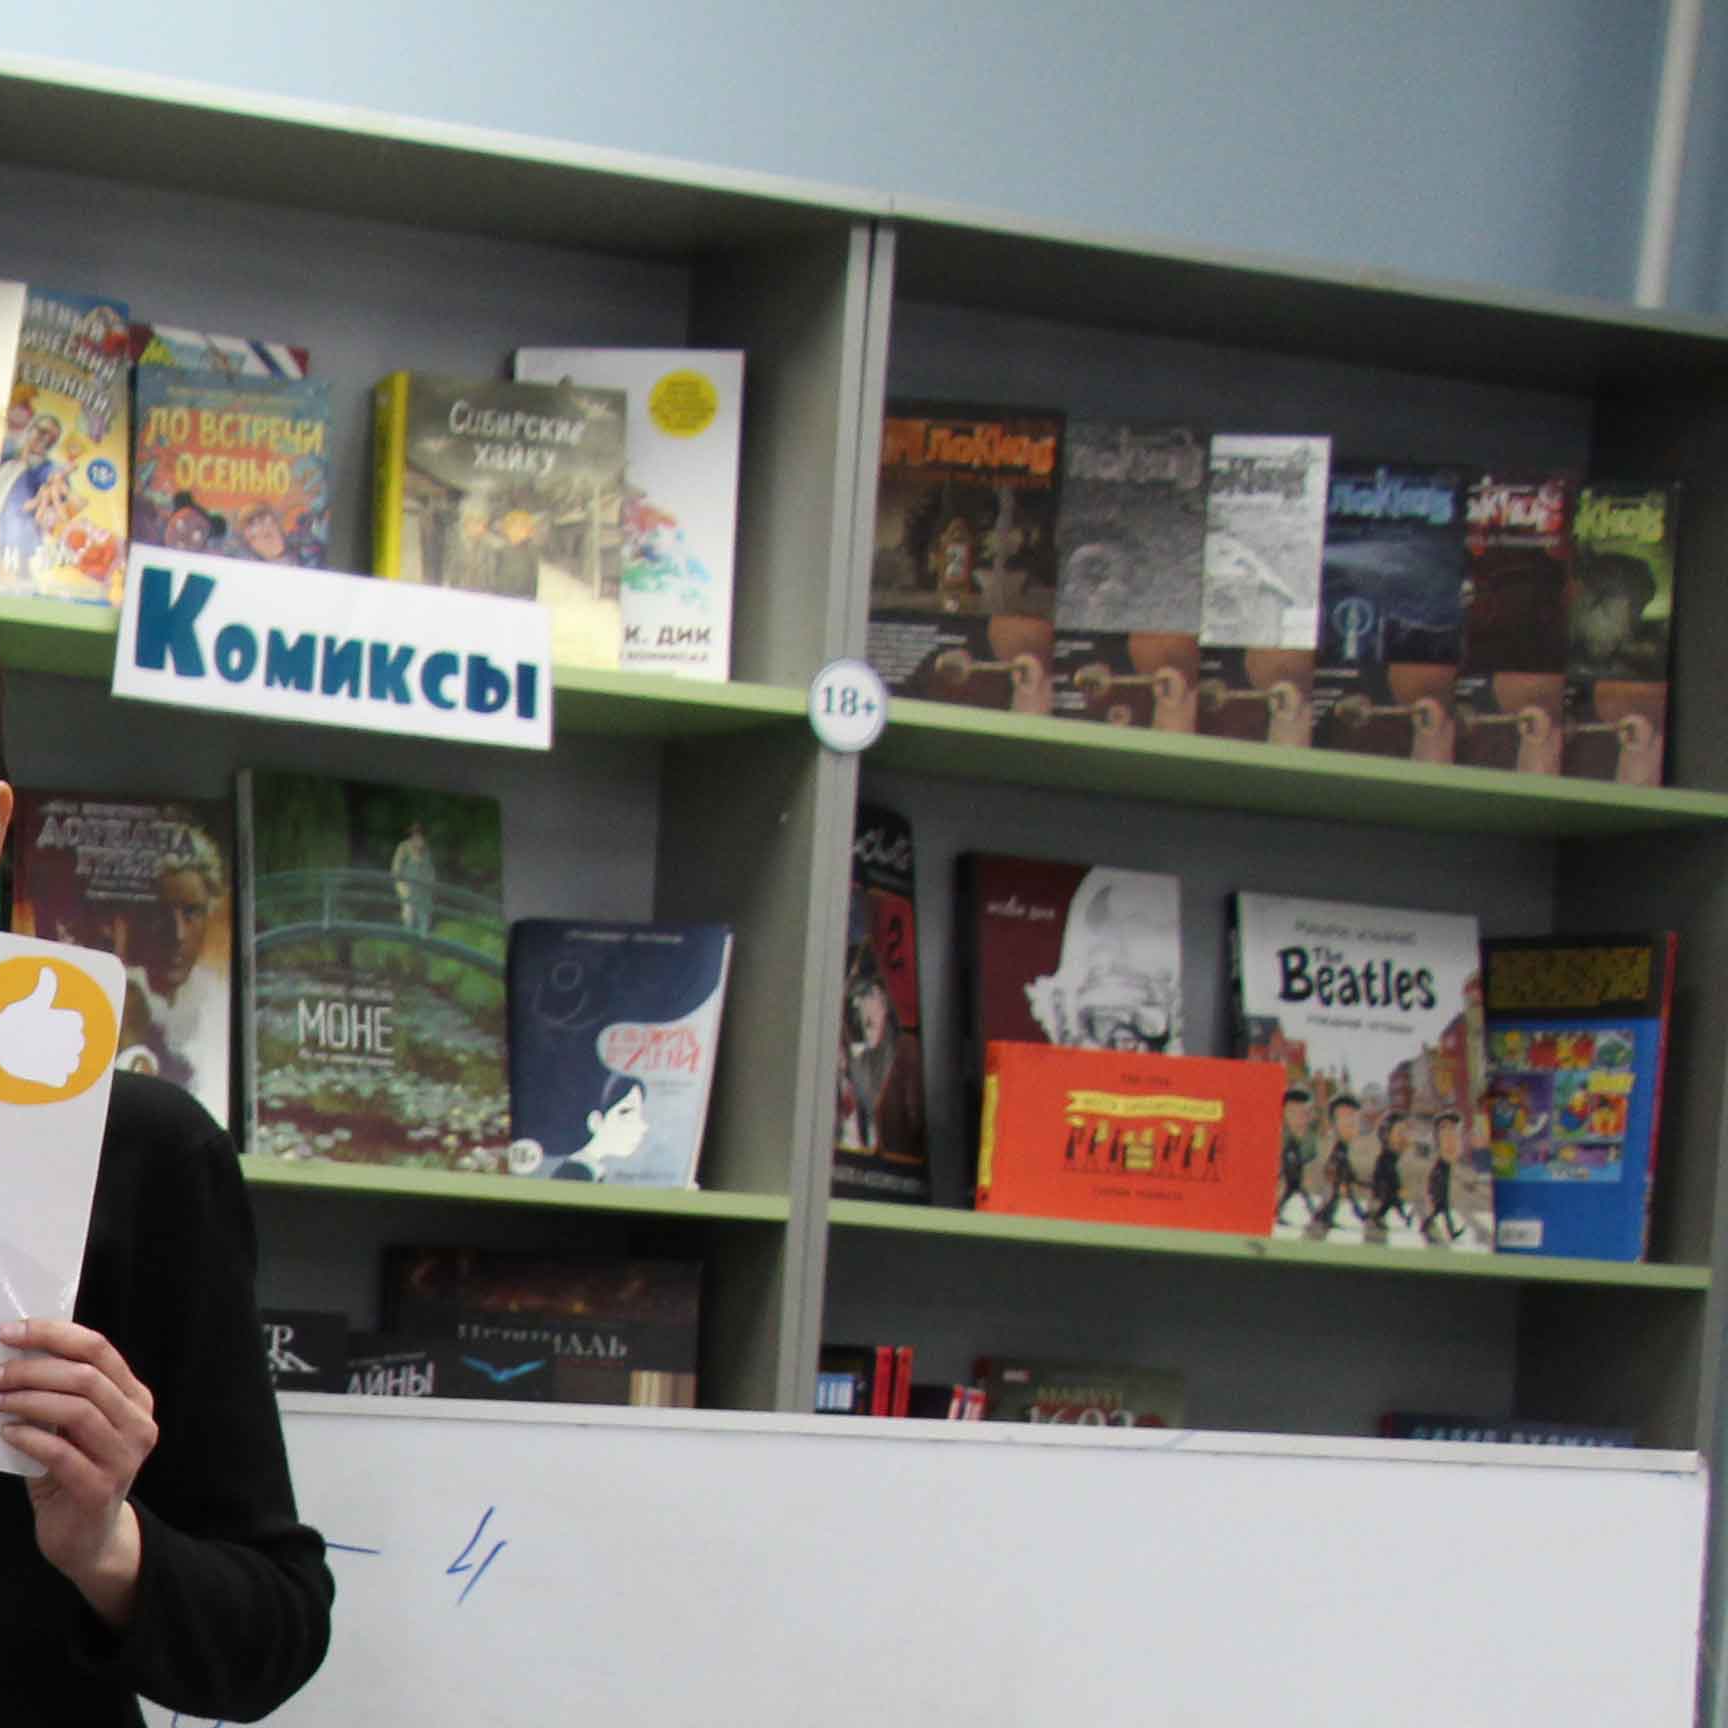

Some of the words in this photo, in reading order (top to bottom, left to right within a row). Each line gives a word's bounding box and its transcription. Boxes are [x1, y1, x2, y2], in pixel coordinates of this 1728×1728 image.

[199, 407, 325, 455] ВСТРЕЧИ
[175, 452, 292, 494] ОСЕНЬЮ
[820, 685, 876, 718] 18+
[1277, 945, 1438, 1012] Beatles
[297, 999, 395, 1054] МОНЕ
[446, 1506, 508, 1606] 4
